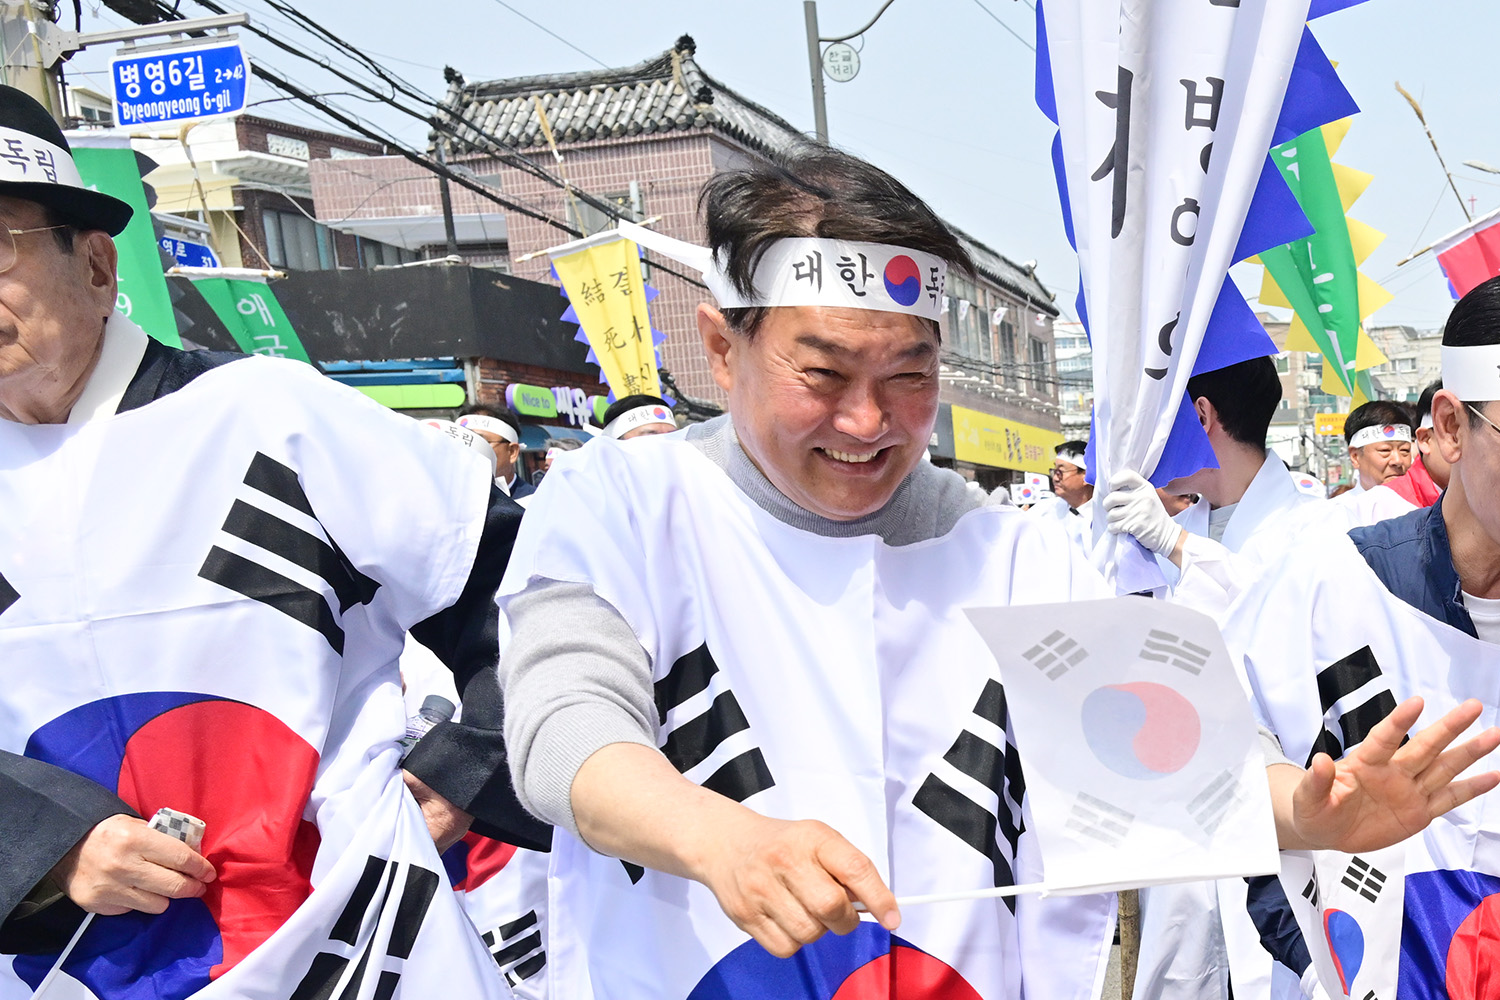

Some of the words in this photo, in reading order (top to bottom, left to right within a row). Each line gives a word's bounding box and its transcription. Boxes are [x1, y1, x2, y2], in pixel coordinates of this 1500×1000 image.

[829, 51, 852, 62] 한글
[831, 64, 853, 75] 거리
[119, 55, 206, 98] 병영6길
[122, 96, 201, 122] Byeongyeong
[203, 89, 231, 112] 6-gil
[0, 138, 58, 184] 독립
[793, 250, 875, 297] 대한
[925, 267, 946, 309] 독
[521, 392, 541, 408] Nice
[541, 396, 550, 408] to
[556, 386, 592, 426] 씨유
